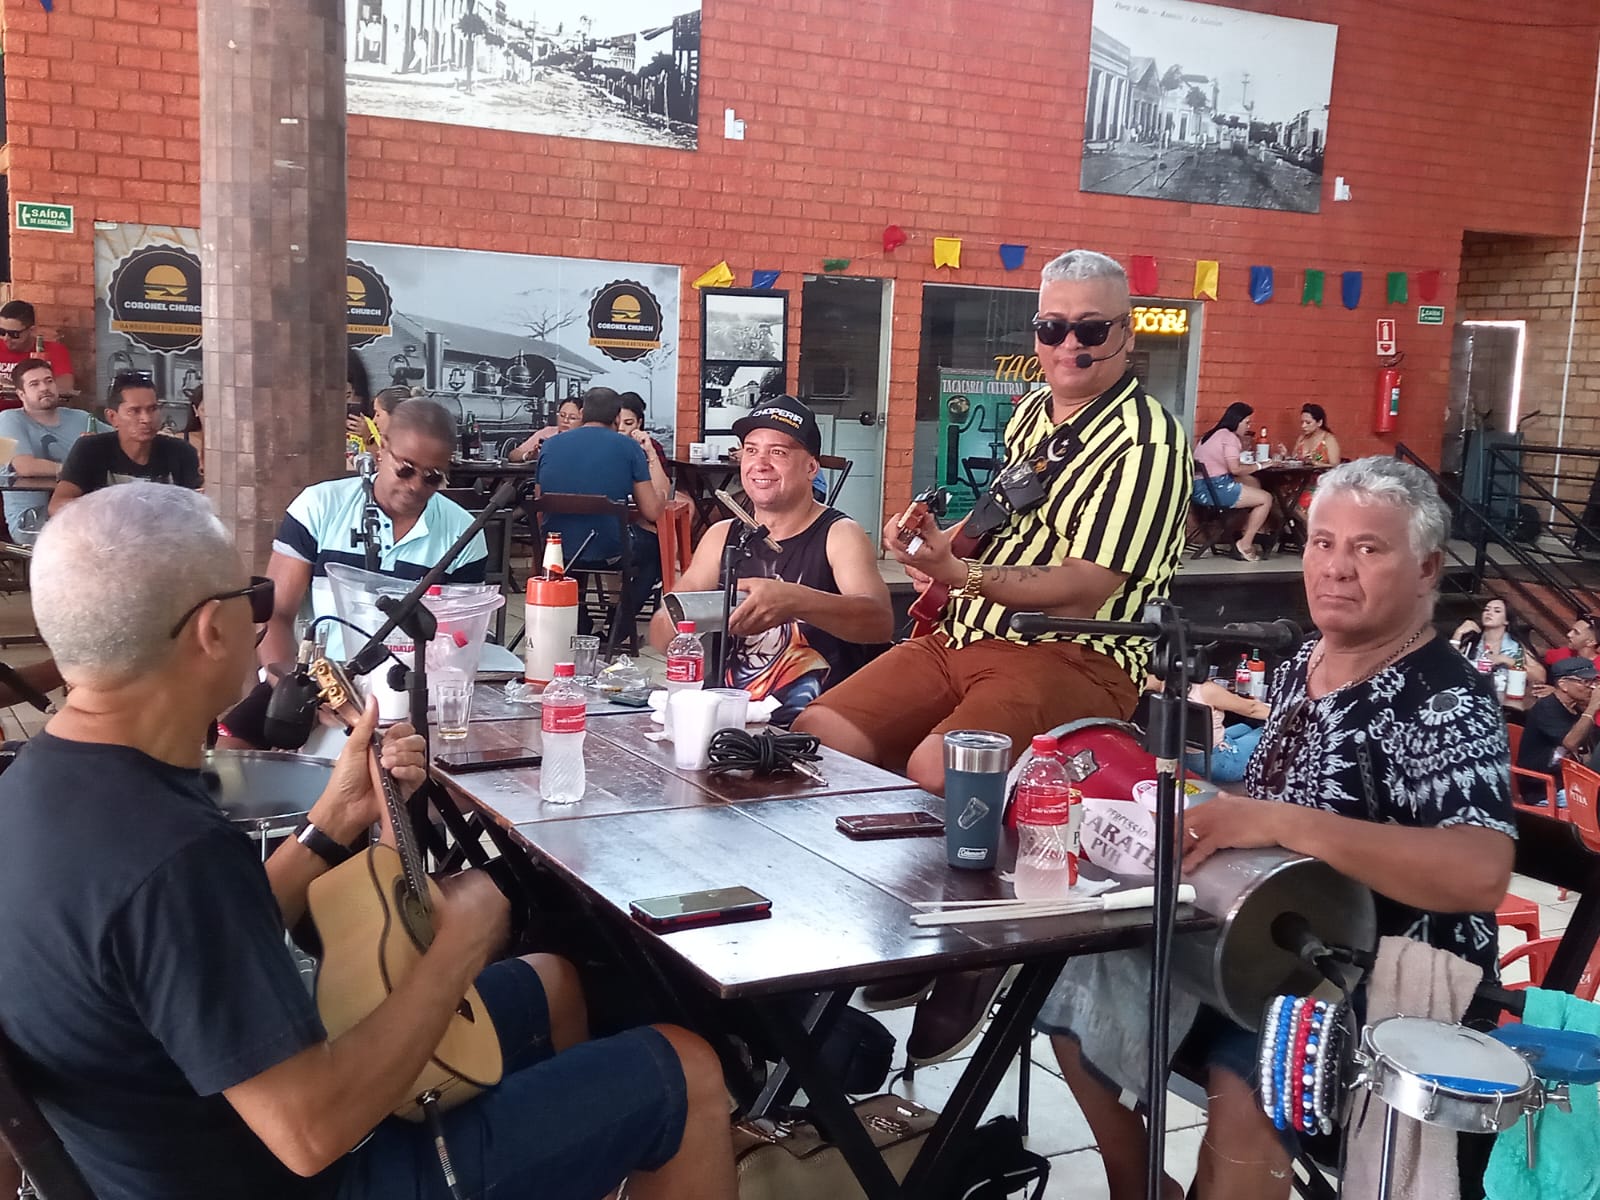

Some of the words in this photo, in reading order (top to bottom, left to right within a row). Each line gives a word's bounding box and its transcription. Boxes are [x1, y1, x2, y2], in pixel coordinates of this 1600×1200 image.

[31, 208, 66, 219] SAÍDA
[124, 301, 168, 311] CORONEL
[169, 304, 202, 312] CHURC
[351, 307, 381, 316] CHURCH
[597, 322, 627, 331] CORONEL
[752, 407, 803, 425] CHOPERIA
